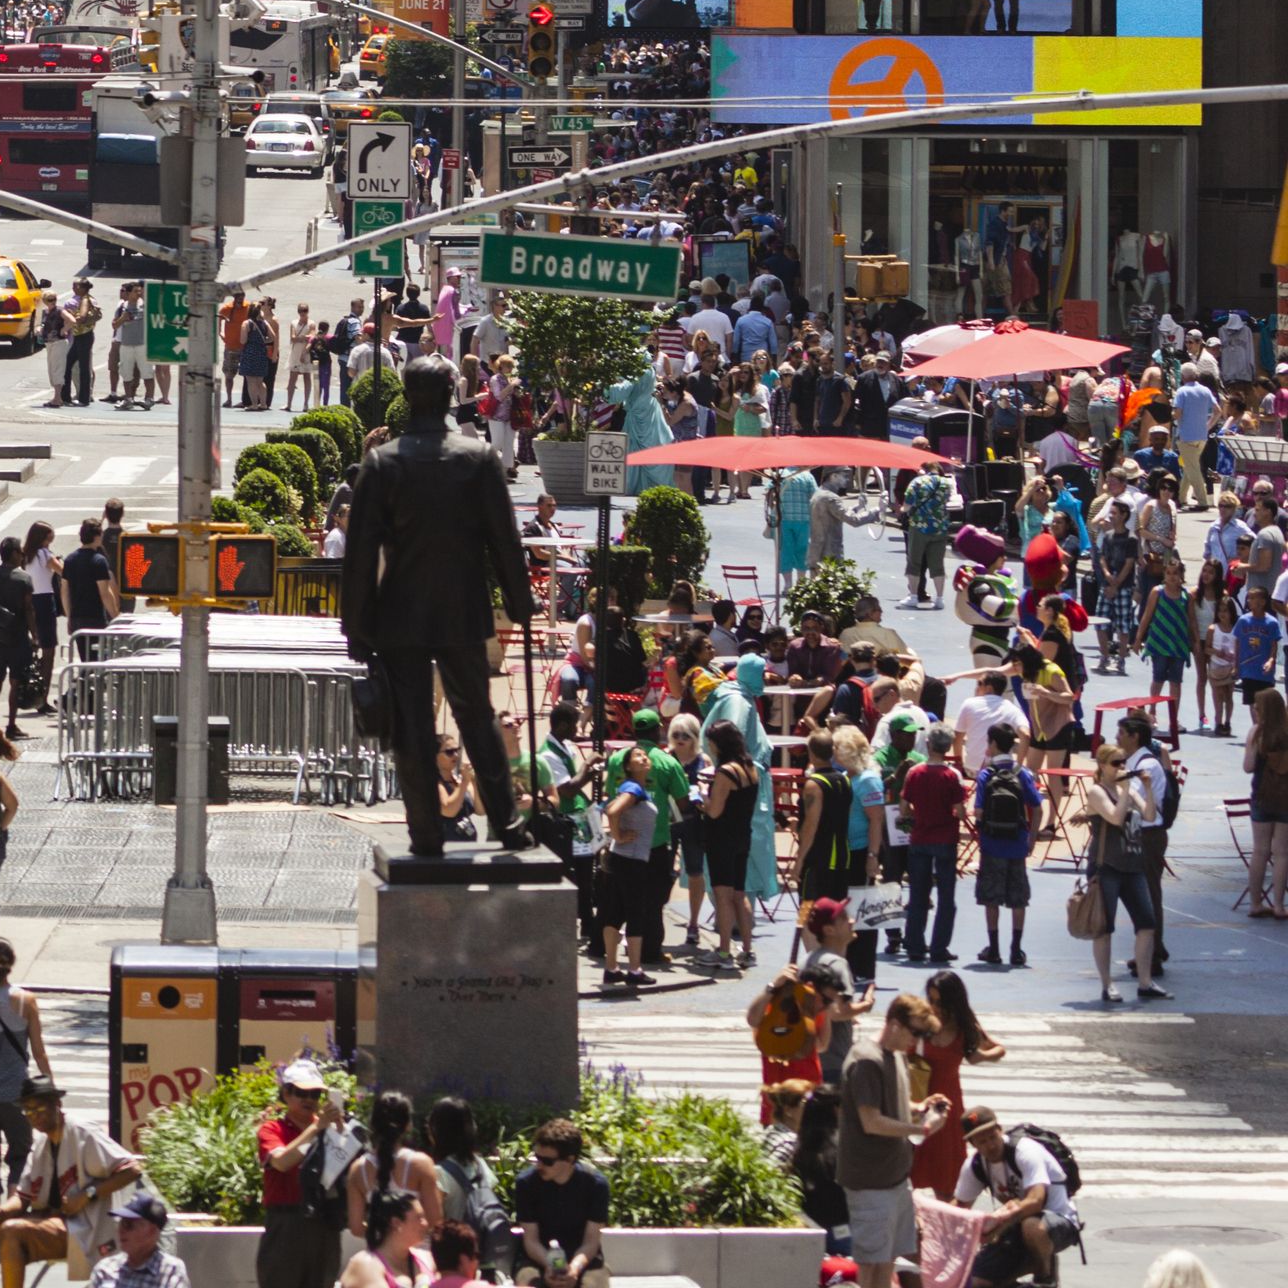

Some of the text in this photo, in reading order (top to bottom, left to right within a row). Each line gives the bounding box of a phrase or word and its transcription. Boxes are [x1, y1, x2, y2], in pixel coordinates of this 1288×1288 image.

[399, 0, 445, 10] JUNE 21
[552, 117, 584, 131] W 45
[517, 152, 564, 162] ONE WAY
[357, 178, 401, 193] ONLY
[510, 246, 651, 291] Broadway
[151, 313, 164, 329] W
[591, 464, 621, 474] WALK
[592, 478, 619, 488] BIKE
[121, 1067, 203, 1121] POP
